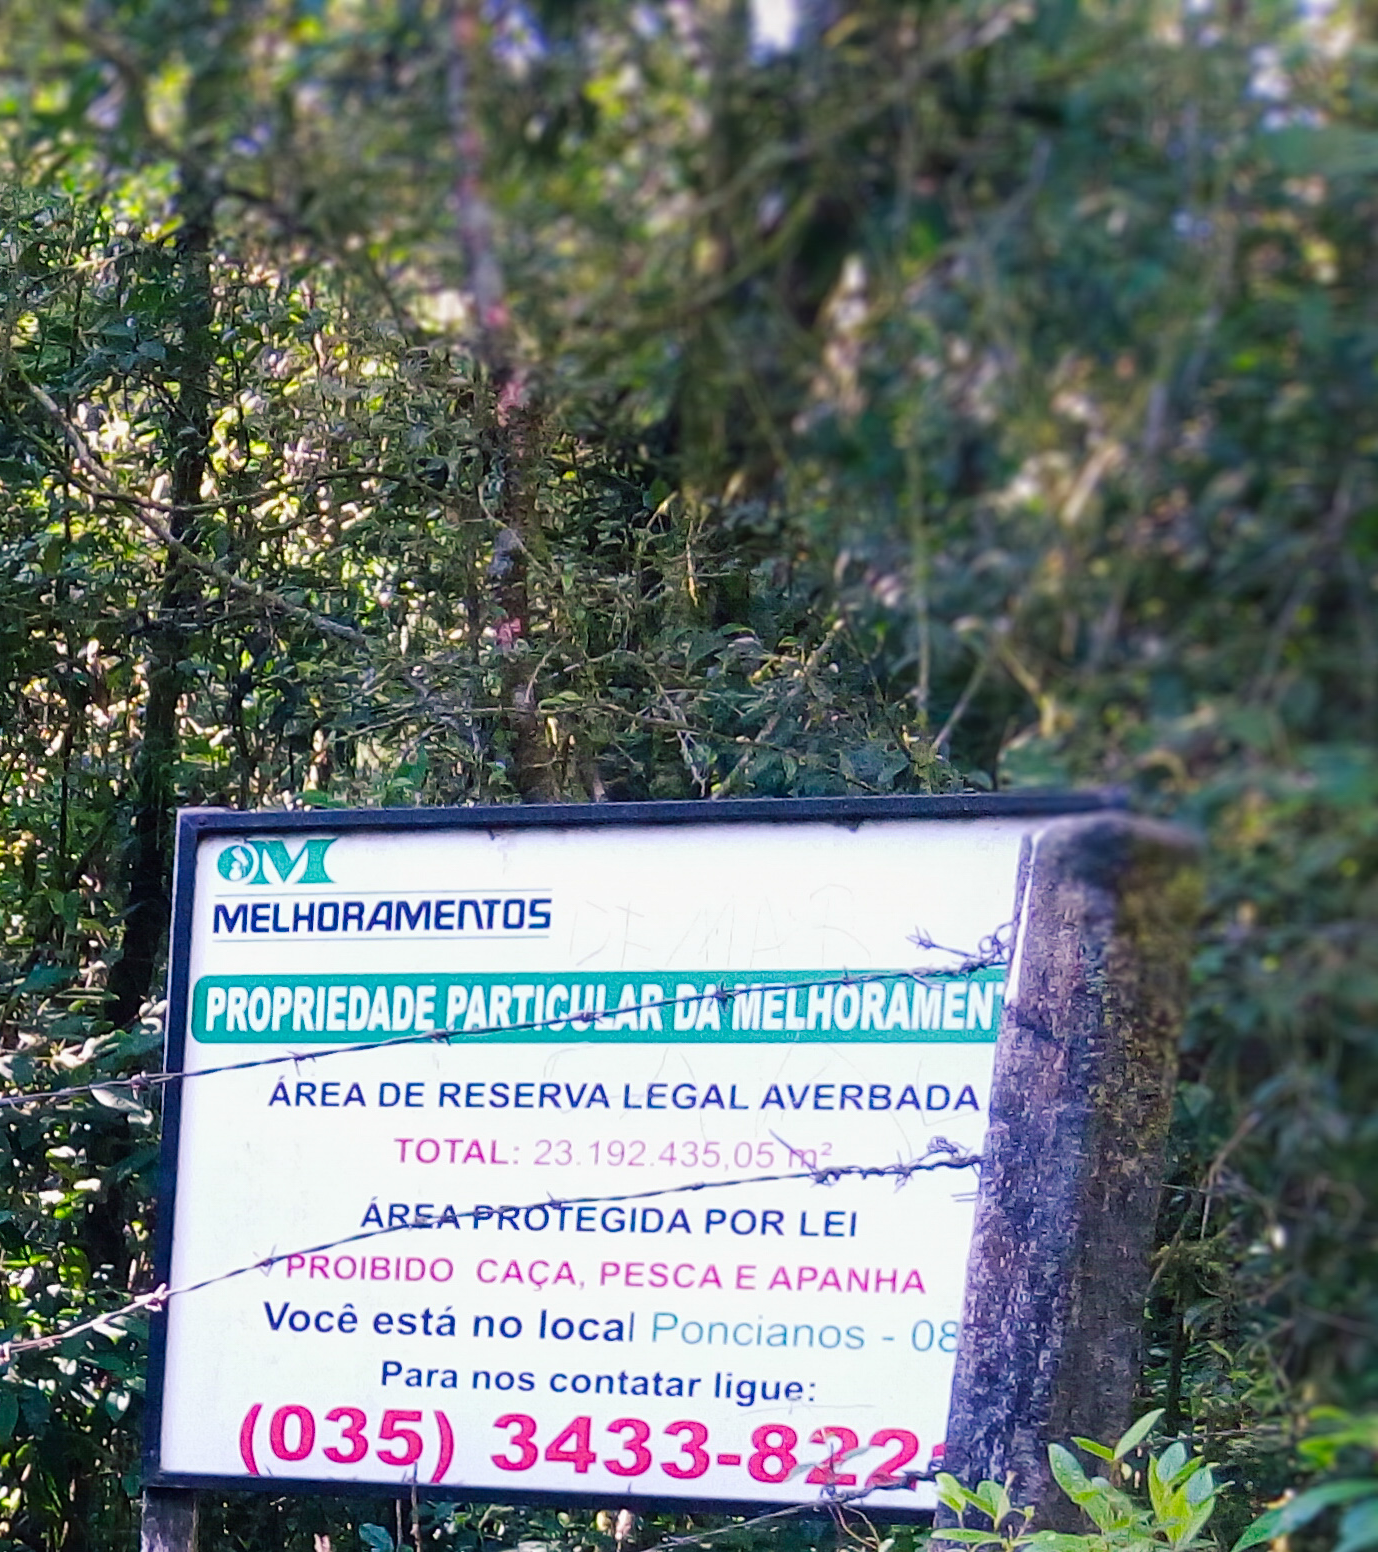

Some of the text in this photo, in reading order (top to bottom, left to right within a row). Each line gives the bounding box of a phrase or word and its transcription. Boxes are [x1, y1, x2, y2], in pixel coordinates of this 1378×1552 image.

[213, 898, 552, 933] MELHORAMENTOS
[205, 981, 1005, 1032] PROPRIEDADE PARTICULAR DA MELHORAMEN
[268, 1075, 981, 1112] ÁREA DE RESERVA LEGAL AVERBADA
[394, 1137, 521, 1165] TOTAL:
[534, 1139, 775, 1171] 23.192.435,05
[360, 1196, 858, 1238] ÁREA PROTEGIDA POR LEI
[285, 1253, 927, 1294] PROIBIDO CAÇA, PESCA E APANHA
[263, 1301, 359, 1334] Você
[372, 1306, 456, 1337] está
[473, 1313, 523, 1339] no
[539, 1309, 634, 1342] local
[652, 1311, 865, 1350] Poncianos
[381, 1360, 817, 1406] Para nos contatar ligue:
[239, 1403, 947, 1490] (035) 3433-822
